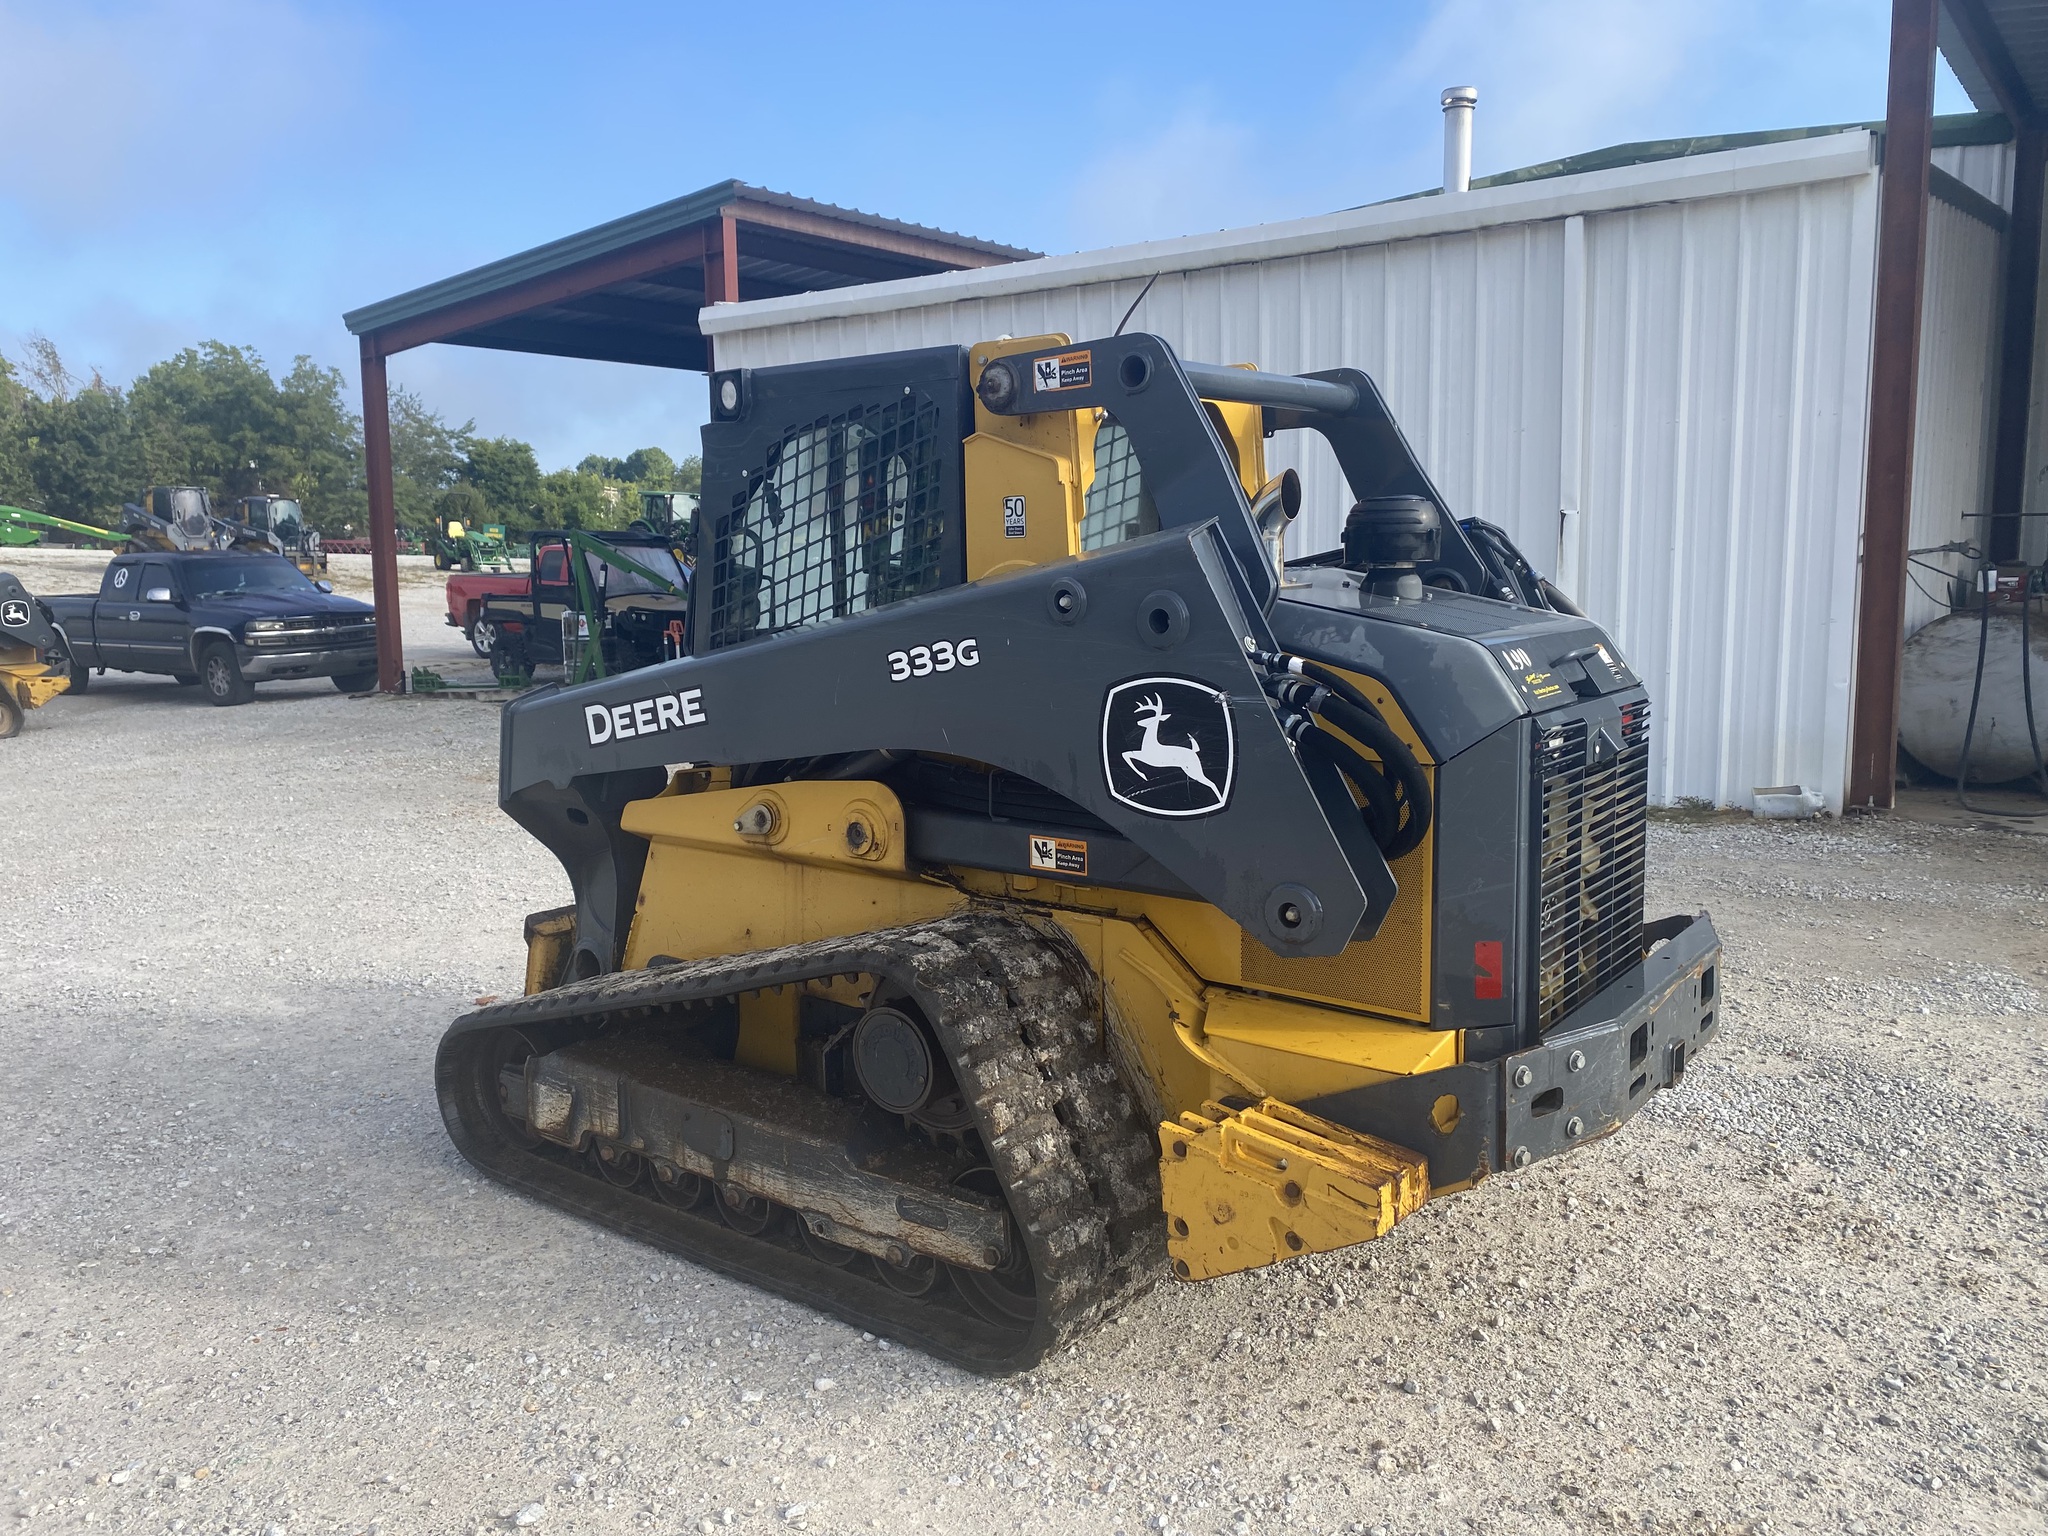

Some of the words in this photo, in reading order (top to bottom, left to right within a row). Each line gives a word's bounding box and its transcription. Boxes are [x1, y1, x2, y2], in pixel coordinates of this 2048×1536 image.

[1005, 498, 1024, 518] 50
[887, 639, 980, 681] 333G
[584, 688, 706, 745] DEERE
